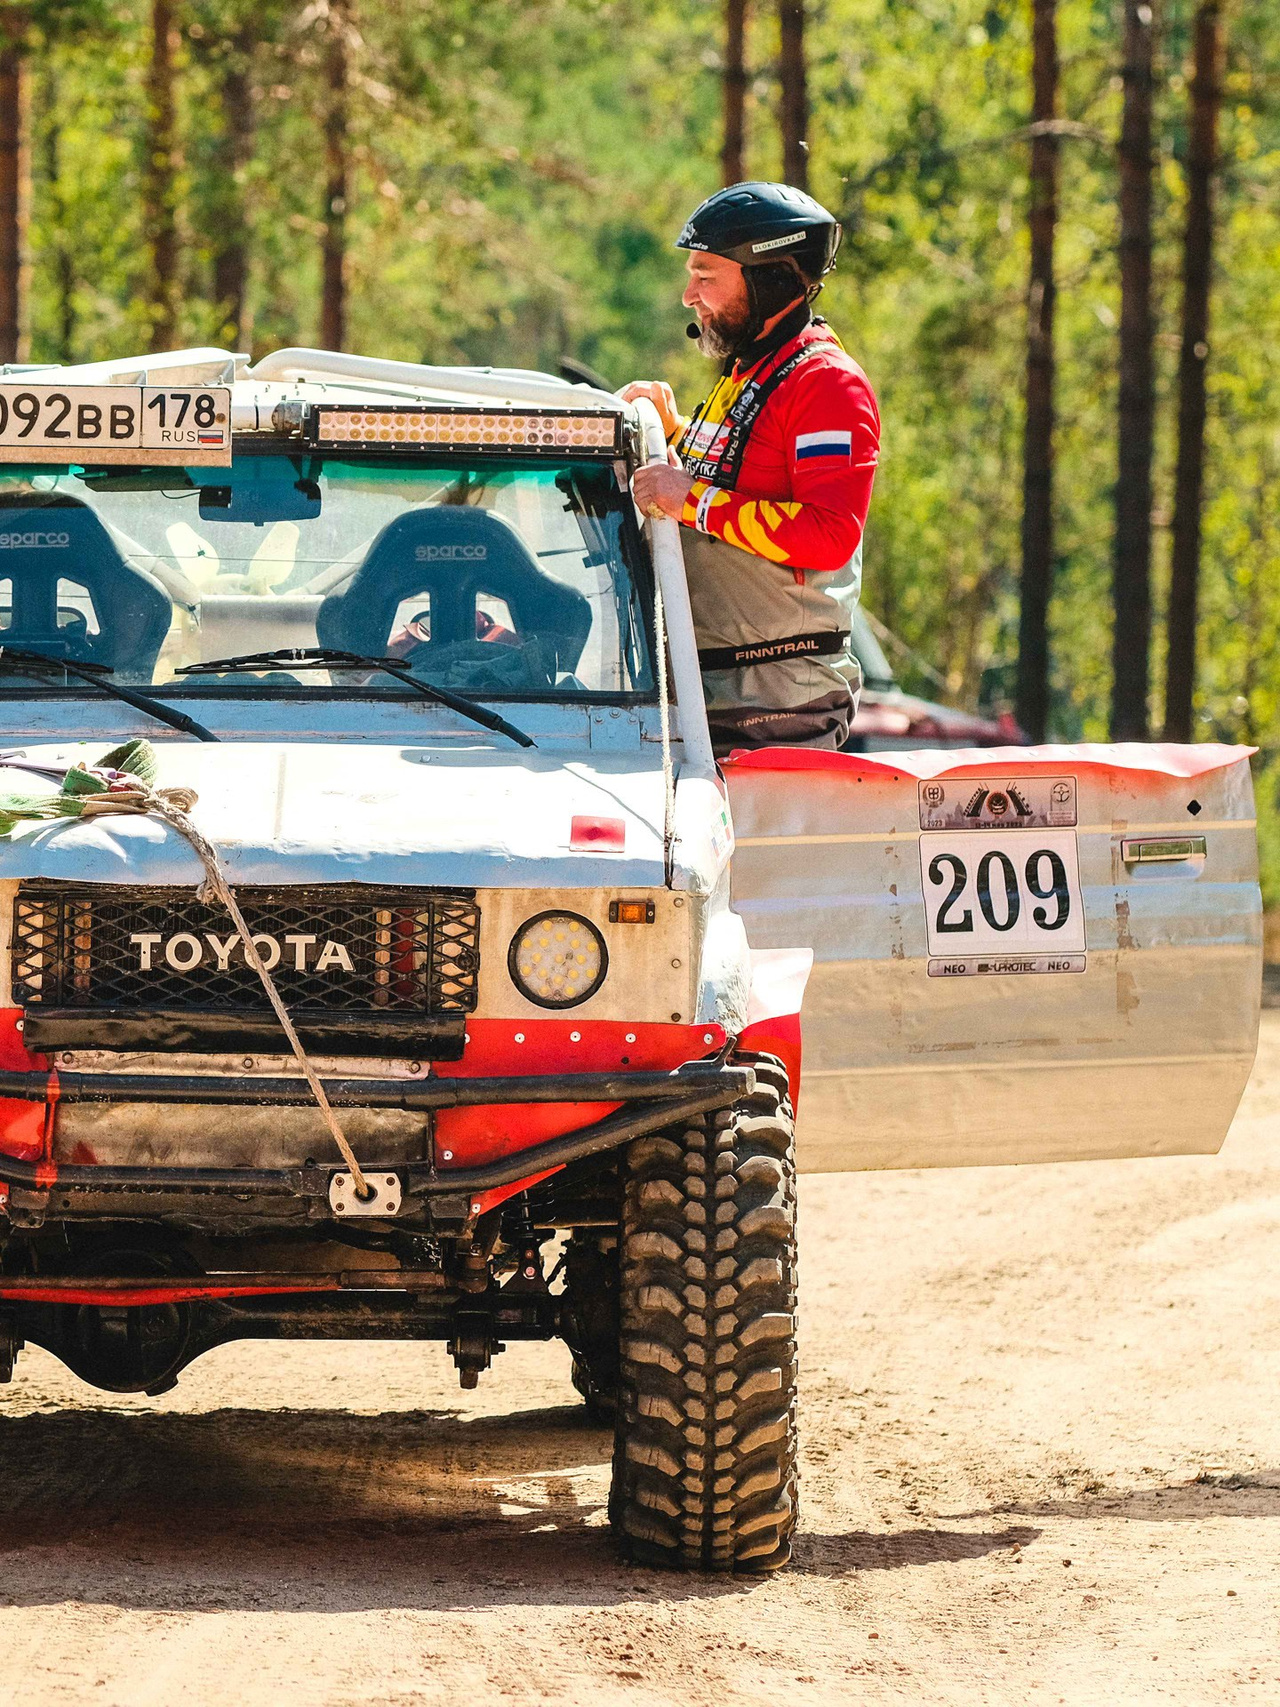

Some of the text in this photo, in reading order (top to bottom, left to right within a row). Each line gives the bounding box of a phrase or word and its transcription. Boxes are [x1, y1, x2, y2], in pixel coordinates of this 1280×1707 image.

[148, 394, 215, 428] 178
[161, 429, 196, 442] RUS
[415, 545, 487, 561] sparco
[735, 639, 819, 661] FINNTRAIL
[928, 849, 1070, 933] 209
[130, 932, 356, 972] TOYOTA
[943, 964, 966, 974] NEO
[1047, 961, 1071, 971] NEO
